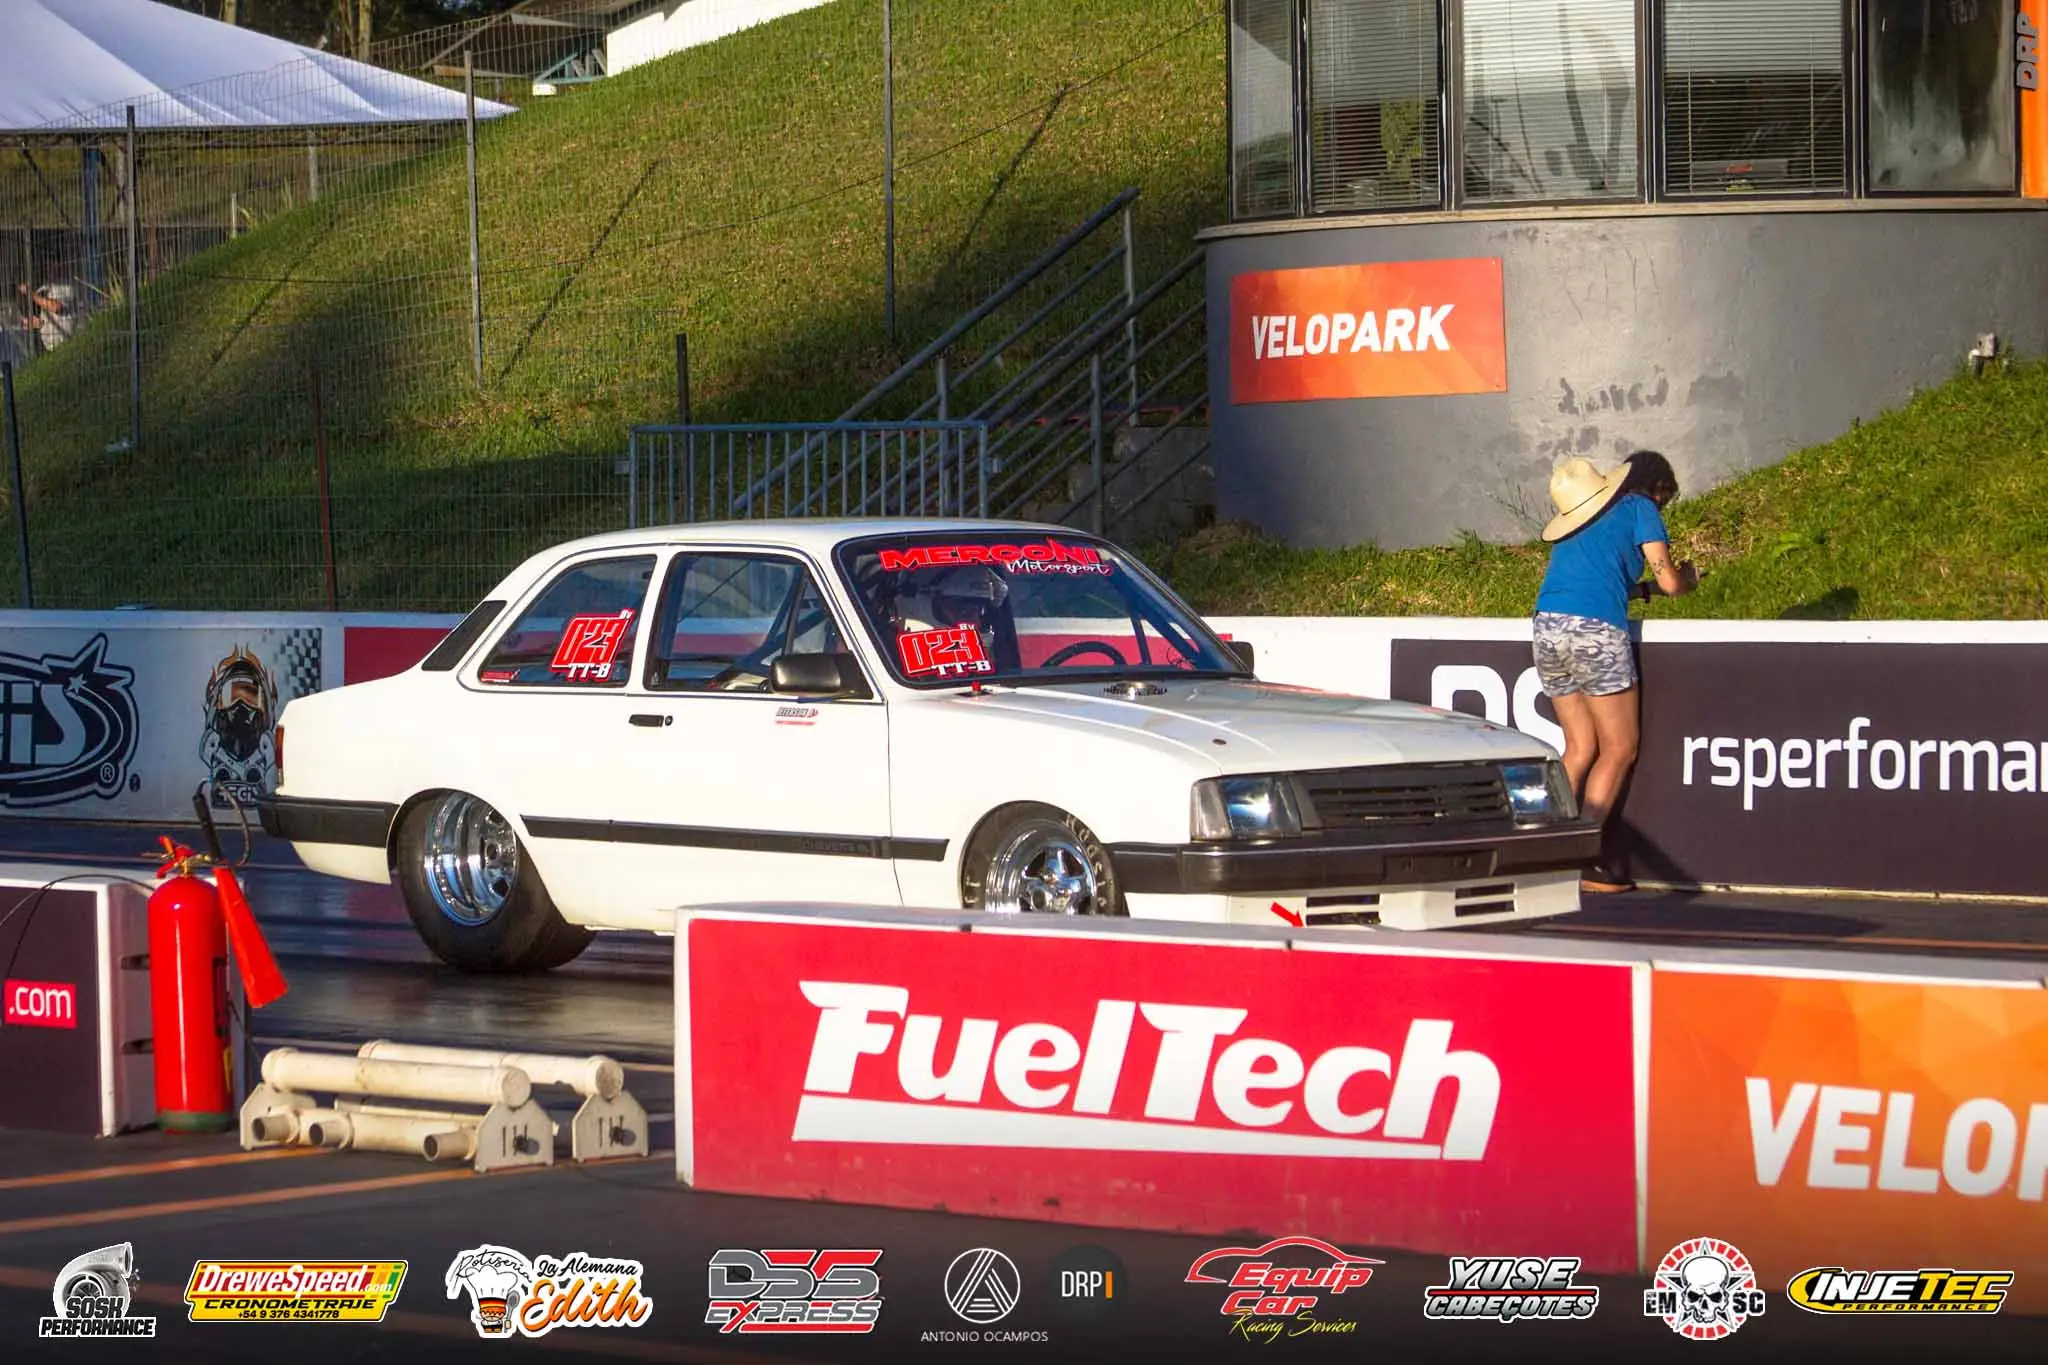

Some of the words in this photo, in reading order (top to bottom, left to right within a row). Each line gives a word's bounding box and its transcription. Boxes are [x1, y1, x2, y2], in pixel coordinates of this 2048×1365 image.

[2016, 12, 2038, 91] DRP
[1252, 304, 1455, 360] VELOPARK
[1006, 559, 1112, 575] Motorsport
[552, 617, 629, 668] 023
[900, 629, 985, 674] 023
[567, 663, 612, 678] TT-B
[932, 661, 992, 676] TT-B
[1683, 717, 2048, 811] rsperforma
[8, 985, 72, 1019] .com
[799, 980, 1500, 1161] FuelTech
